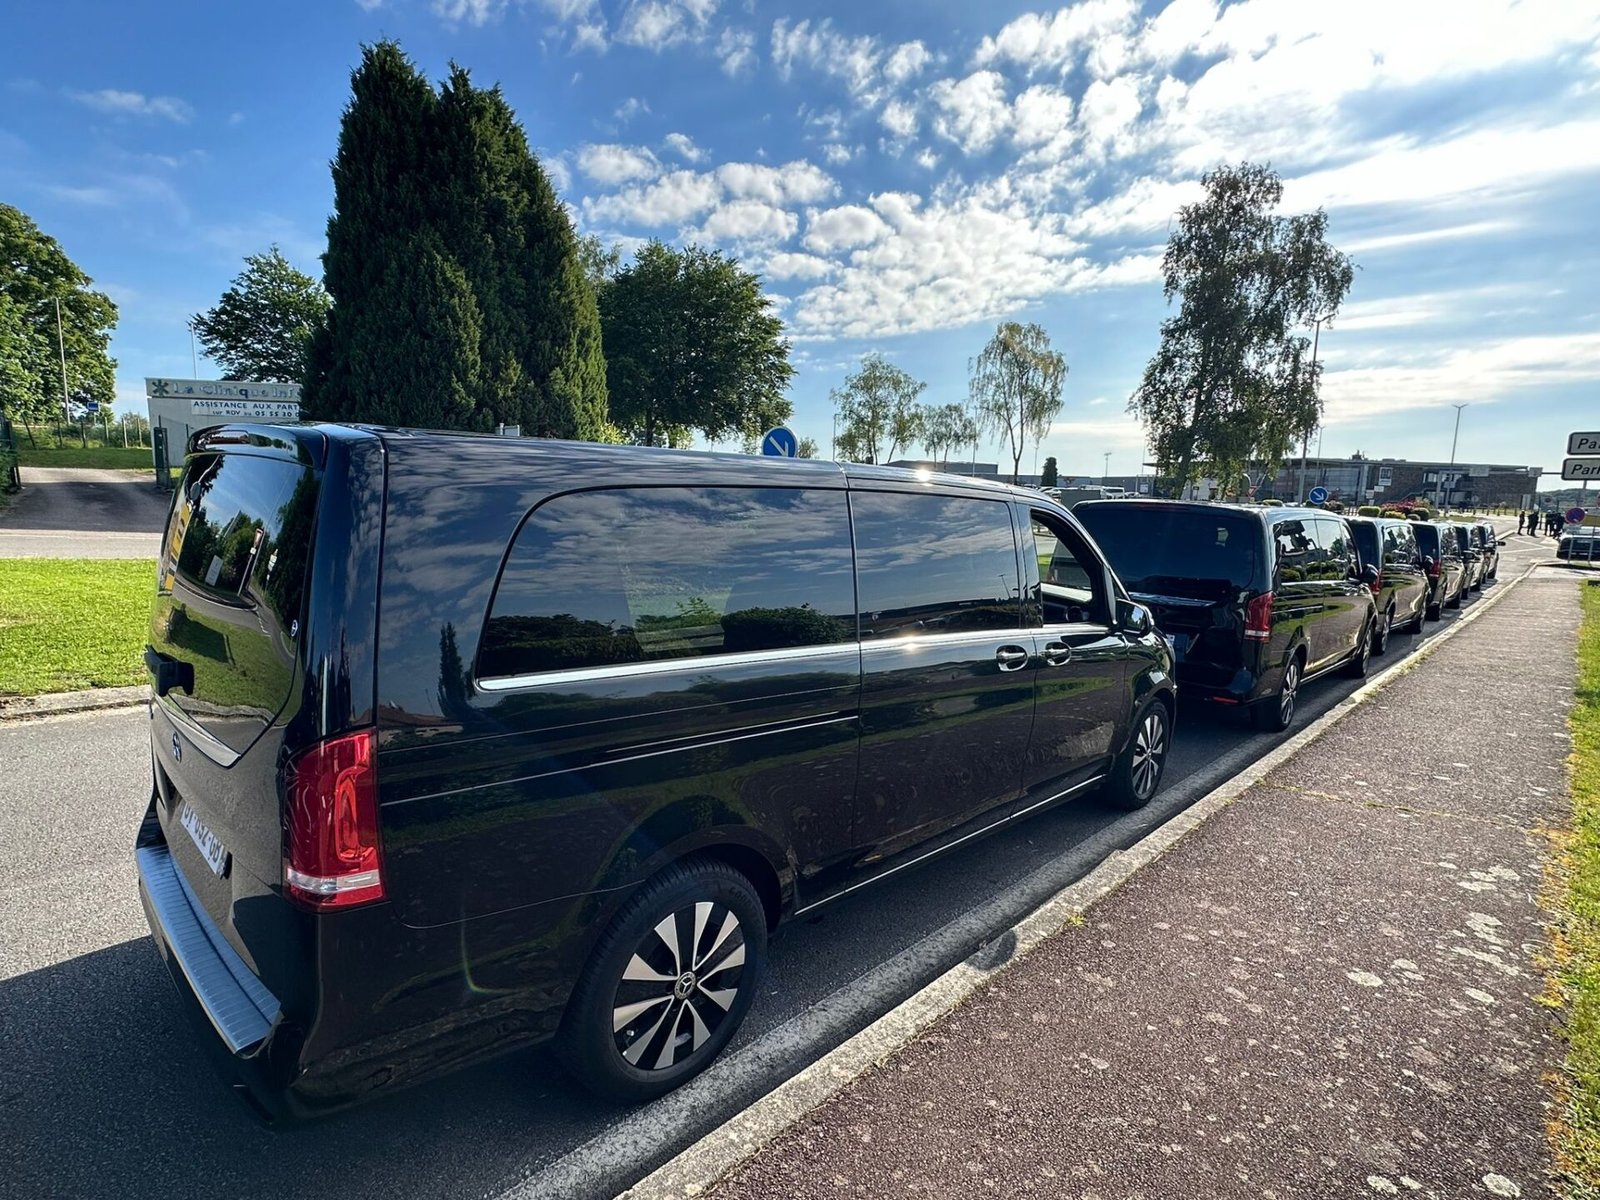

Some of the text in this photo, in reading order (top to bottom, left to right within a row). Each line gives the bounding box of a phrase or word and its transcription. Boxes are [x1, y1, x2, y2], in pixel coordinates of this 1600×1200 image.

[174, 383, 194, 395] La
[199, 385, 269, 398] Clinique
[193, 401, 247, 409] ASSISTANCE
[1577, 437, 1600, 450] Pa
